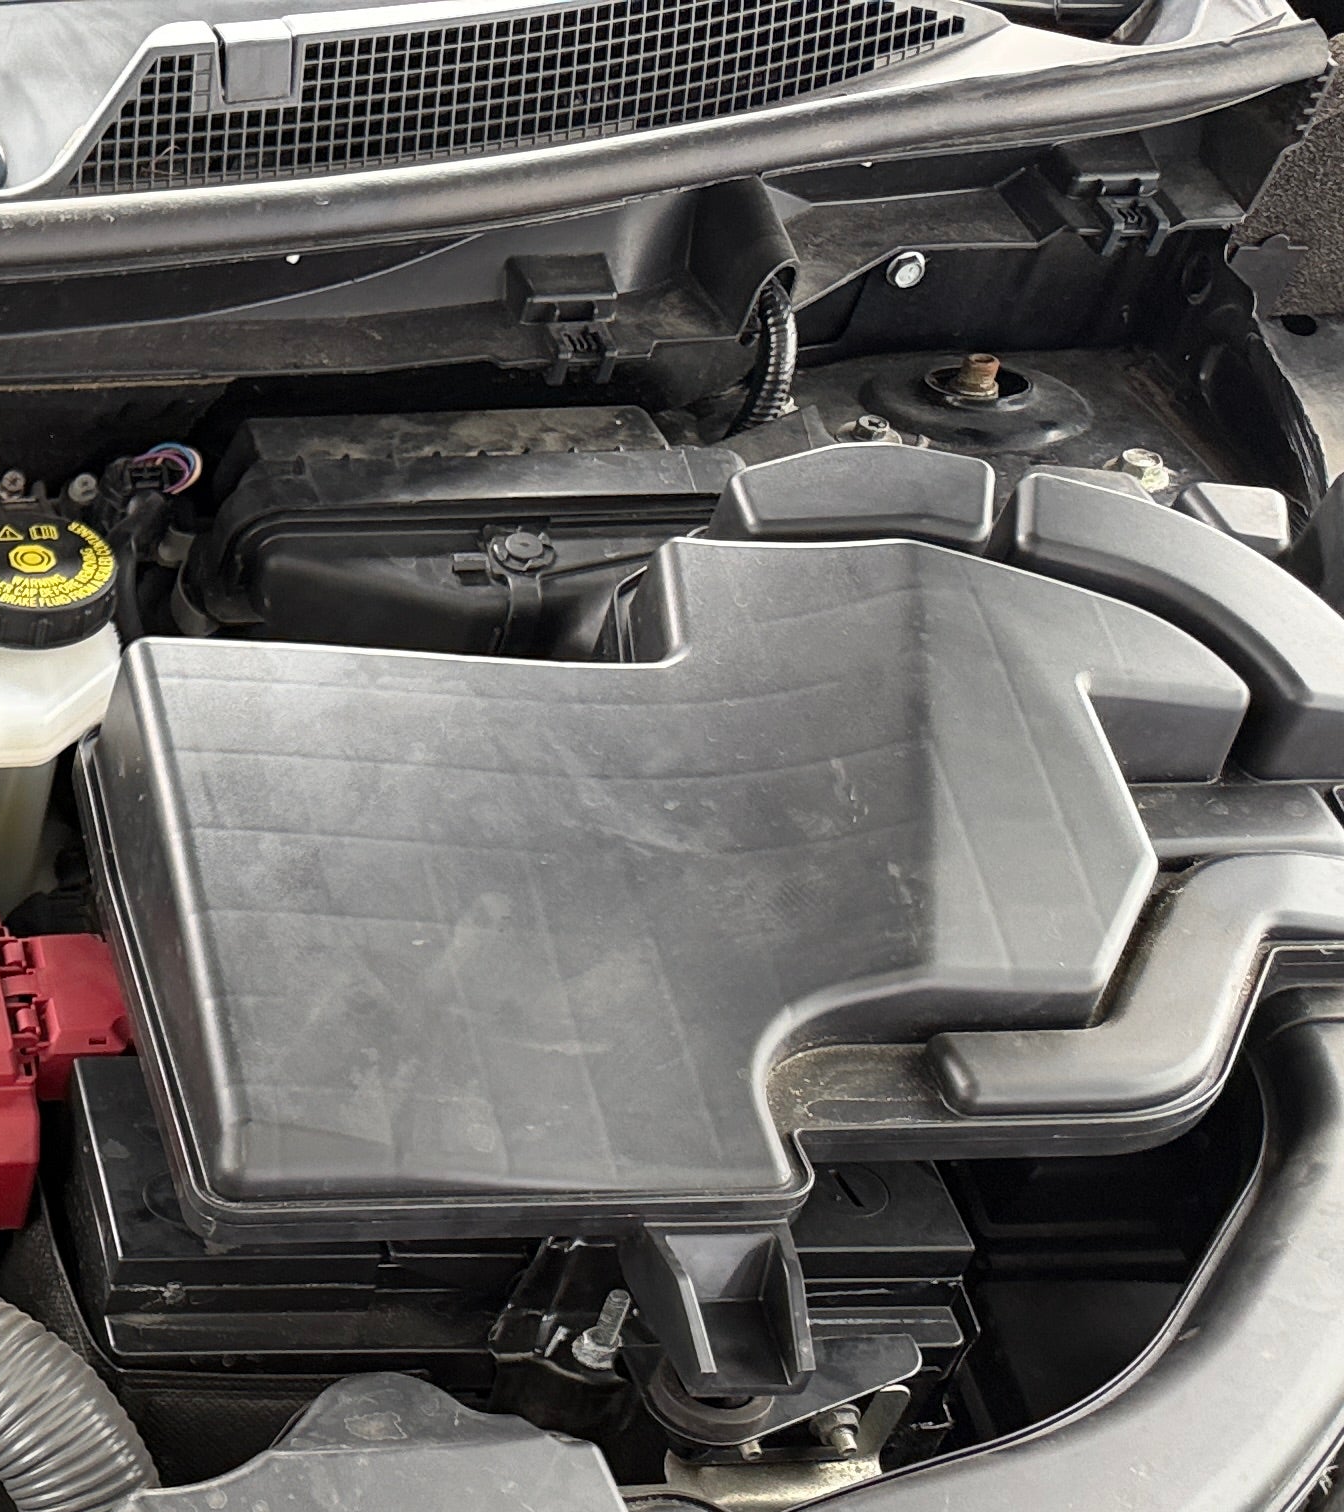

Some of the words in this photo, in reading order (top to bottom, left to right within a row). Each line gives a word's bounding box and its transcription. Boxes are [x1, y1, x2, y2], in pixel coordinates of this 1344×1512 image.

[11, 573, 67, 588] WARNING
[13, 586, 38, 598] CAP
[39, 579, 83, 597] BEFORE
[0, 593, 37, 608] BRAKE
[38, 594, 72, 607] FLUID
